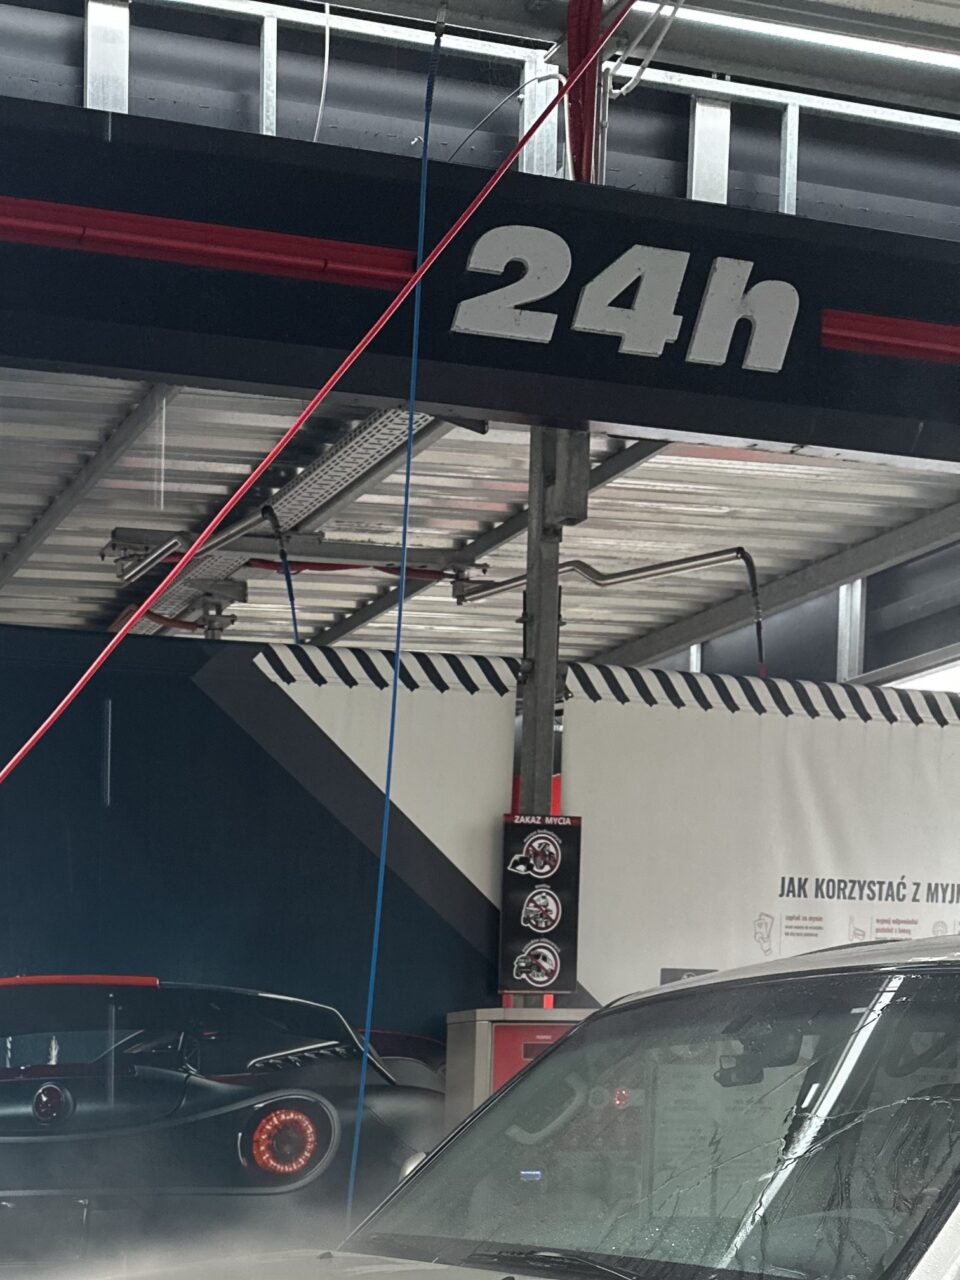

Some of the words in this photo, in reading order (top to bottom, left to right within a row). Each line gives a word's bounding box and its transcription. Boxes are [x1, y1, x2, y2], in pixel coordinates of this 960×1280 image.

[450, 224, 800, 374] 24h
[514, 815, 542, 824] ZAKAZ
[545, 816, 572, 825] MYCIA
[778, 876, 809, 898] JAK
[814, 875, 907, 902] KORZYSTAĆ
[912, 882, 921, 903] Z
